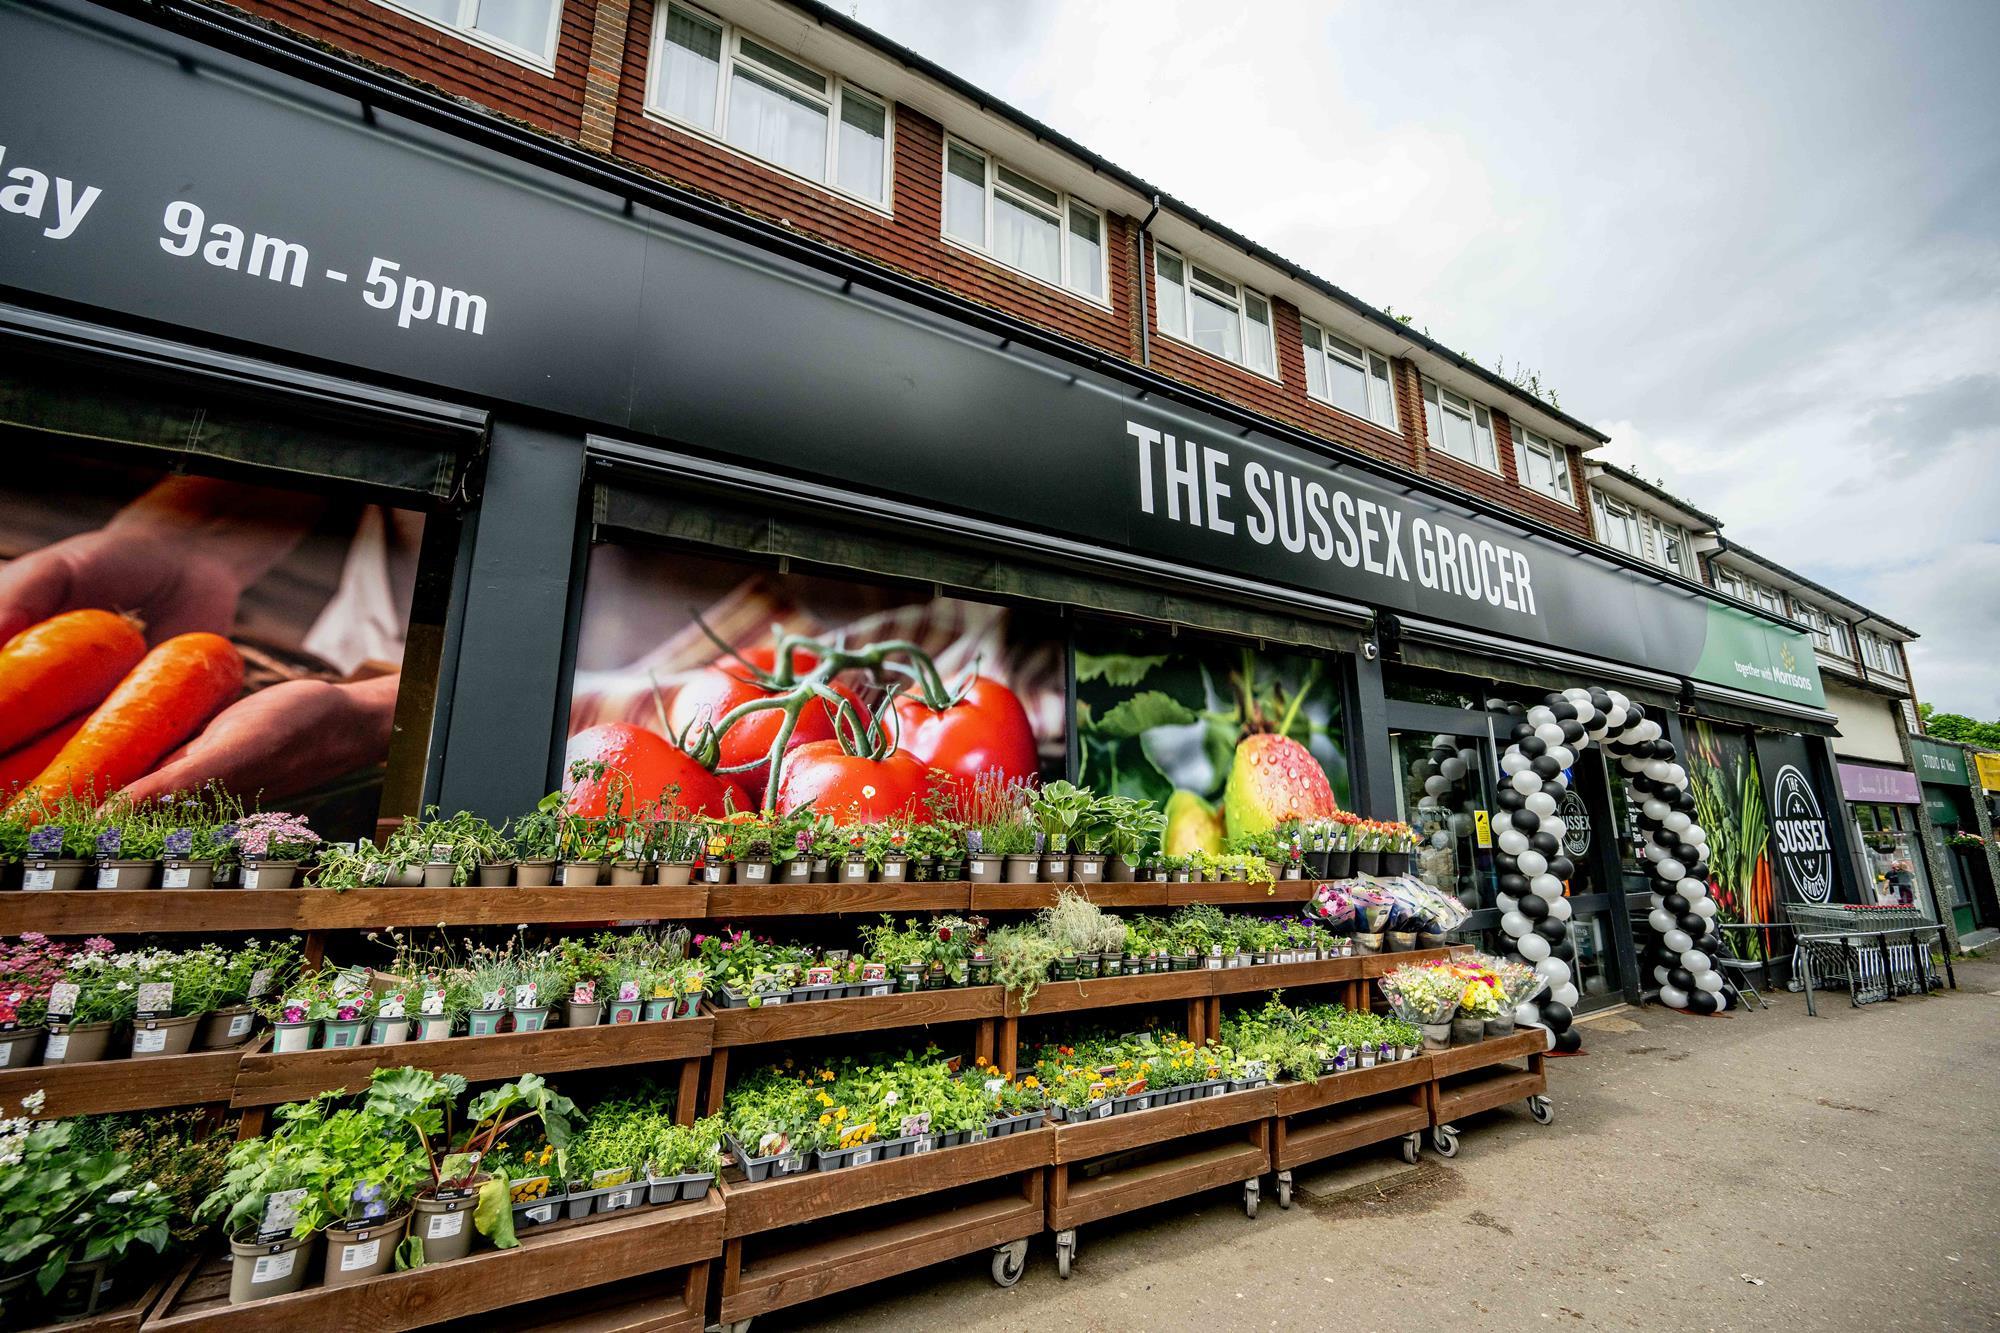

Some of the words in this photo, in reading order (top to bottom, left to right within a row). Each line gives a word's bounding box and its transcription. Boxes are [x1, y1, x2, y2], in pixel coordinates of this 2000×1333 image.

[0, 145, 102, 240] ay
[159, 200, 310, 288] 9am
[362, 255, 489, 336] 5pm
[1126, 420, 1235, 536] THE
[1244, 461, 1410, 583] SUSSEX
[1413, 518, 1537, 616] GROCER
[1772, 665, 1813, 692] Morrisons
[1785, 777, 1800, 792] THE
[1560, 815, 1592, 831] USSEX
[1775, 820, 1832, 854] SUSSEX
[1802, 873, 1827, 897] GROCER
